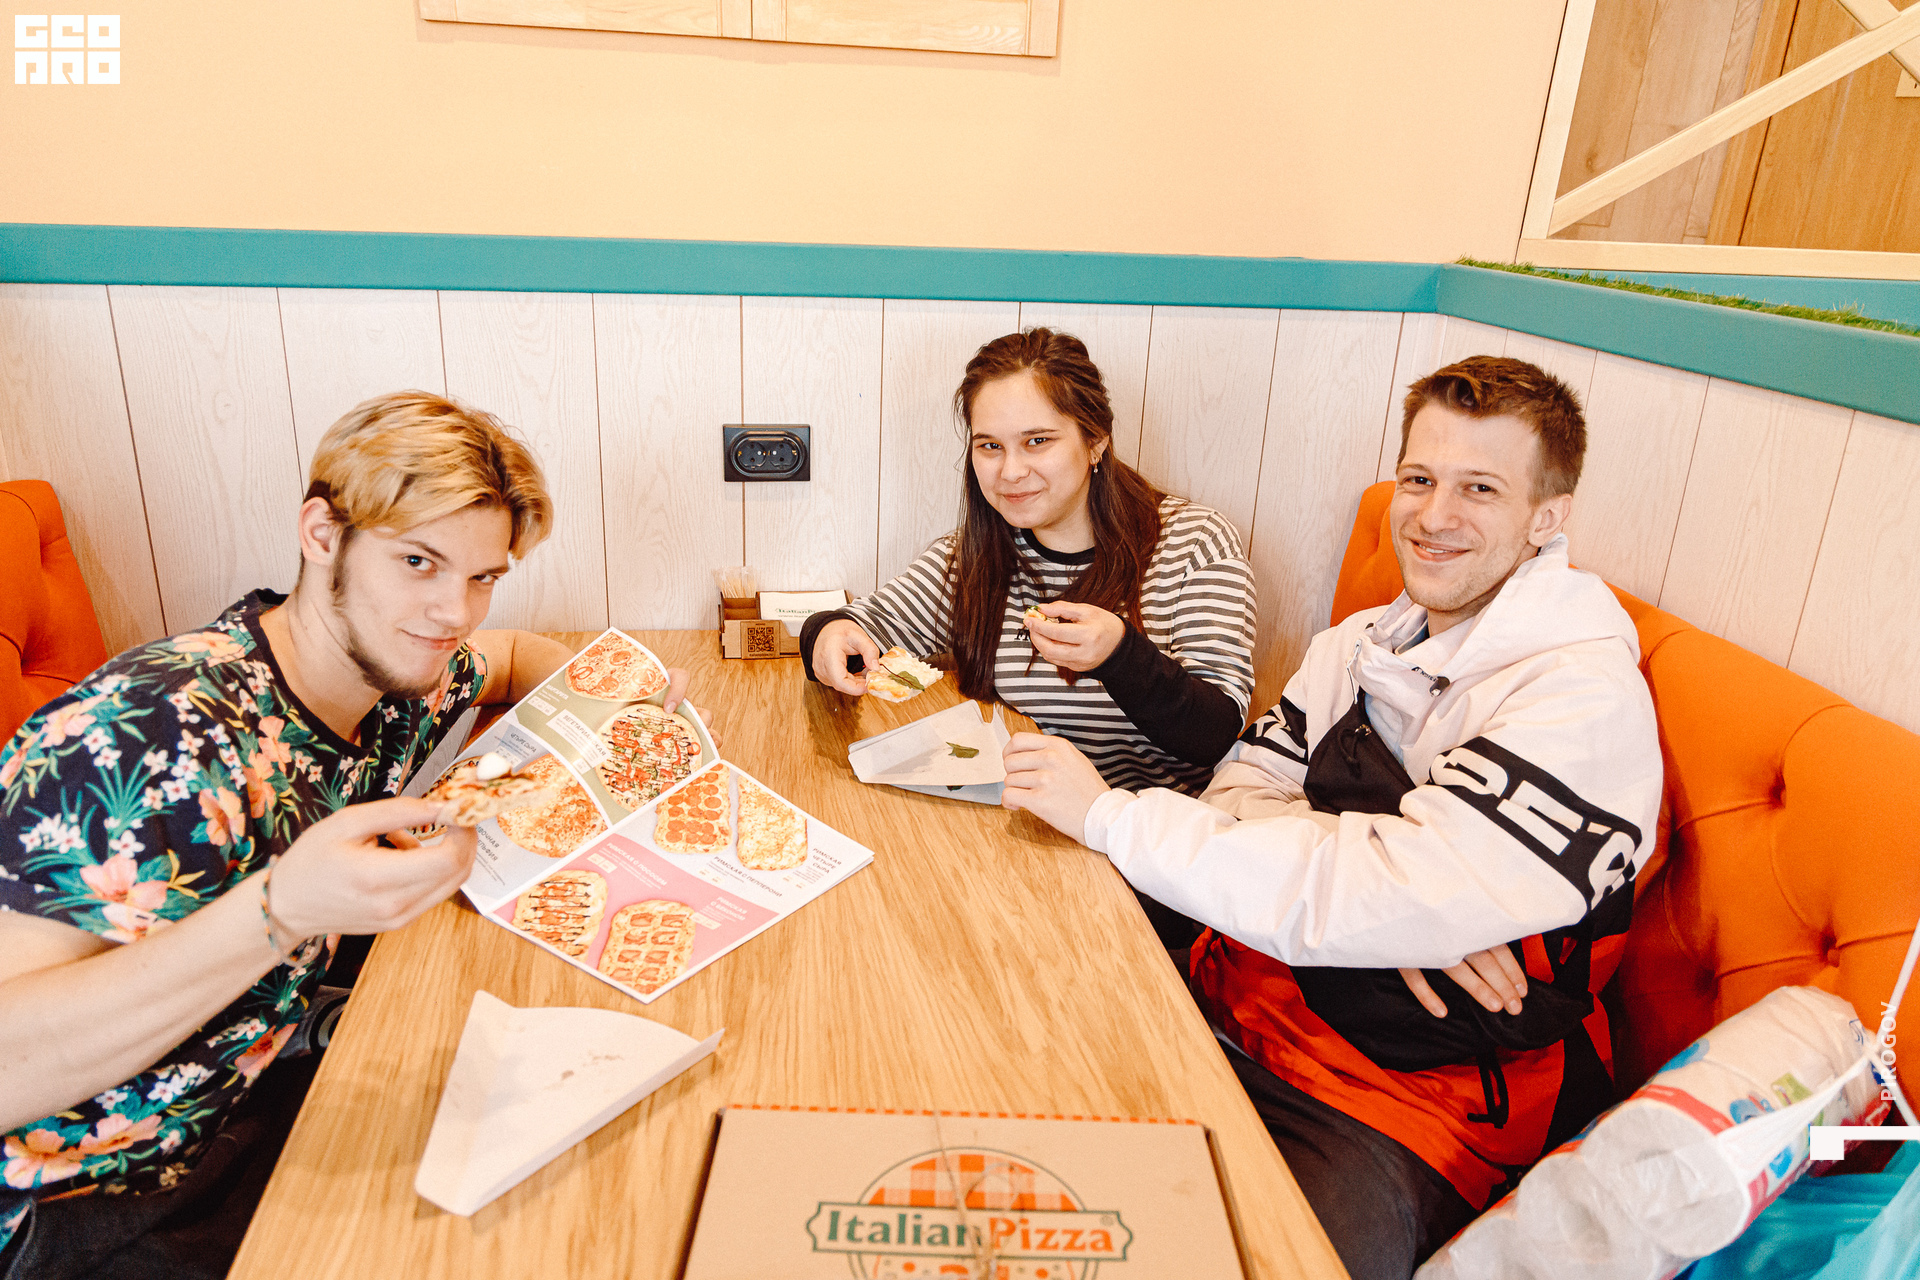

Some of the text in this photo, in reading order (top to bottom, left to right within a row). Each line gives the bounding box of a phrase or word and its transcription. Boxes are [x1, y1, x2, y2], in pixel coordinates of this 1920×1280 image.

[475, 824, 500, 848] ИВОЧНАЯ
[477, 840, 498, 861] ЕЛЬФИЯ
[606, 842, 635, 863] РИМСКАЯ
[813, 847, 842, 865] РИМСКАЯ
[812, 855, 836, 869] ЧЕТЫРЕ
[812, 863, 830, 874] СЫРА
[713, 856, 743, 875] РИМСКАЯ
[746, 875, 783, 898] ПЕППЕРОНИ
[717, 896, 748, 914] РИМСКАЯ
